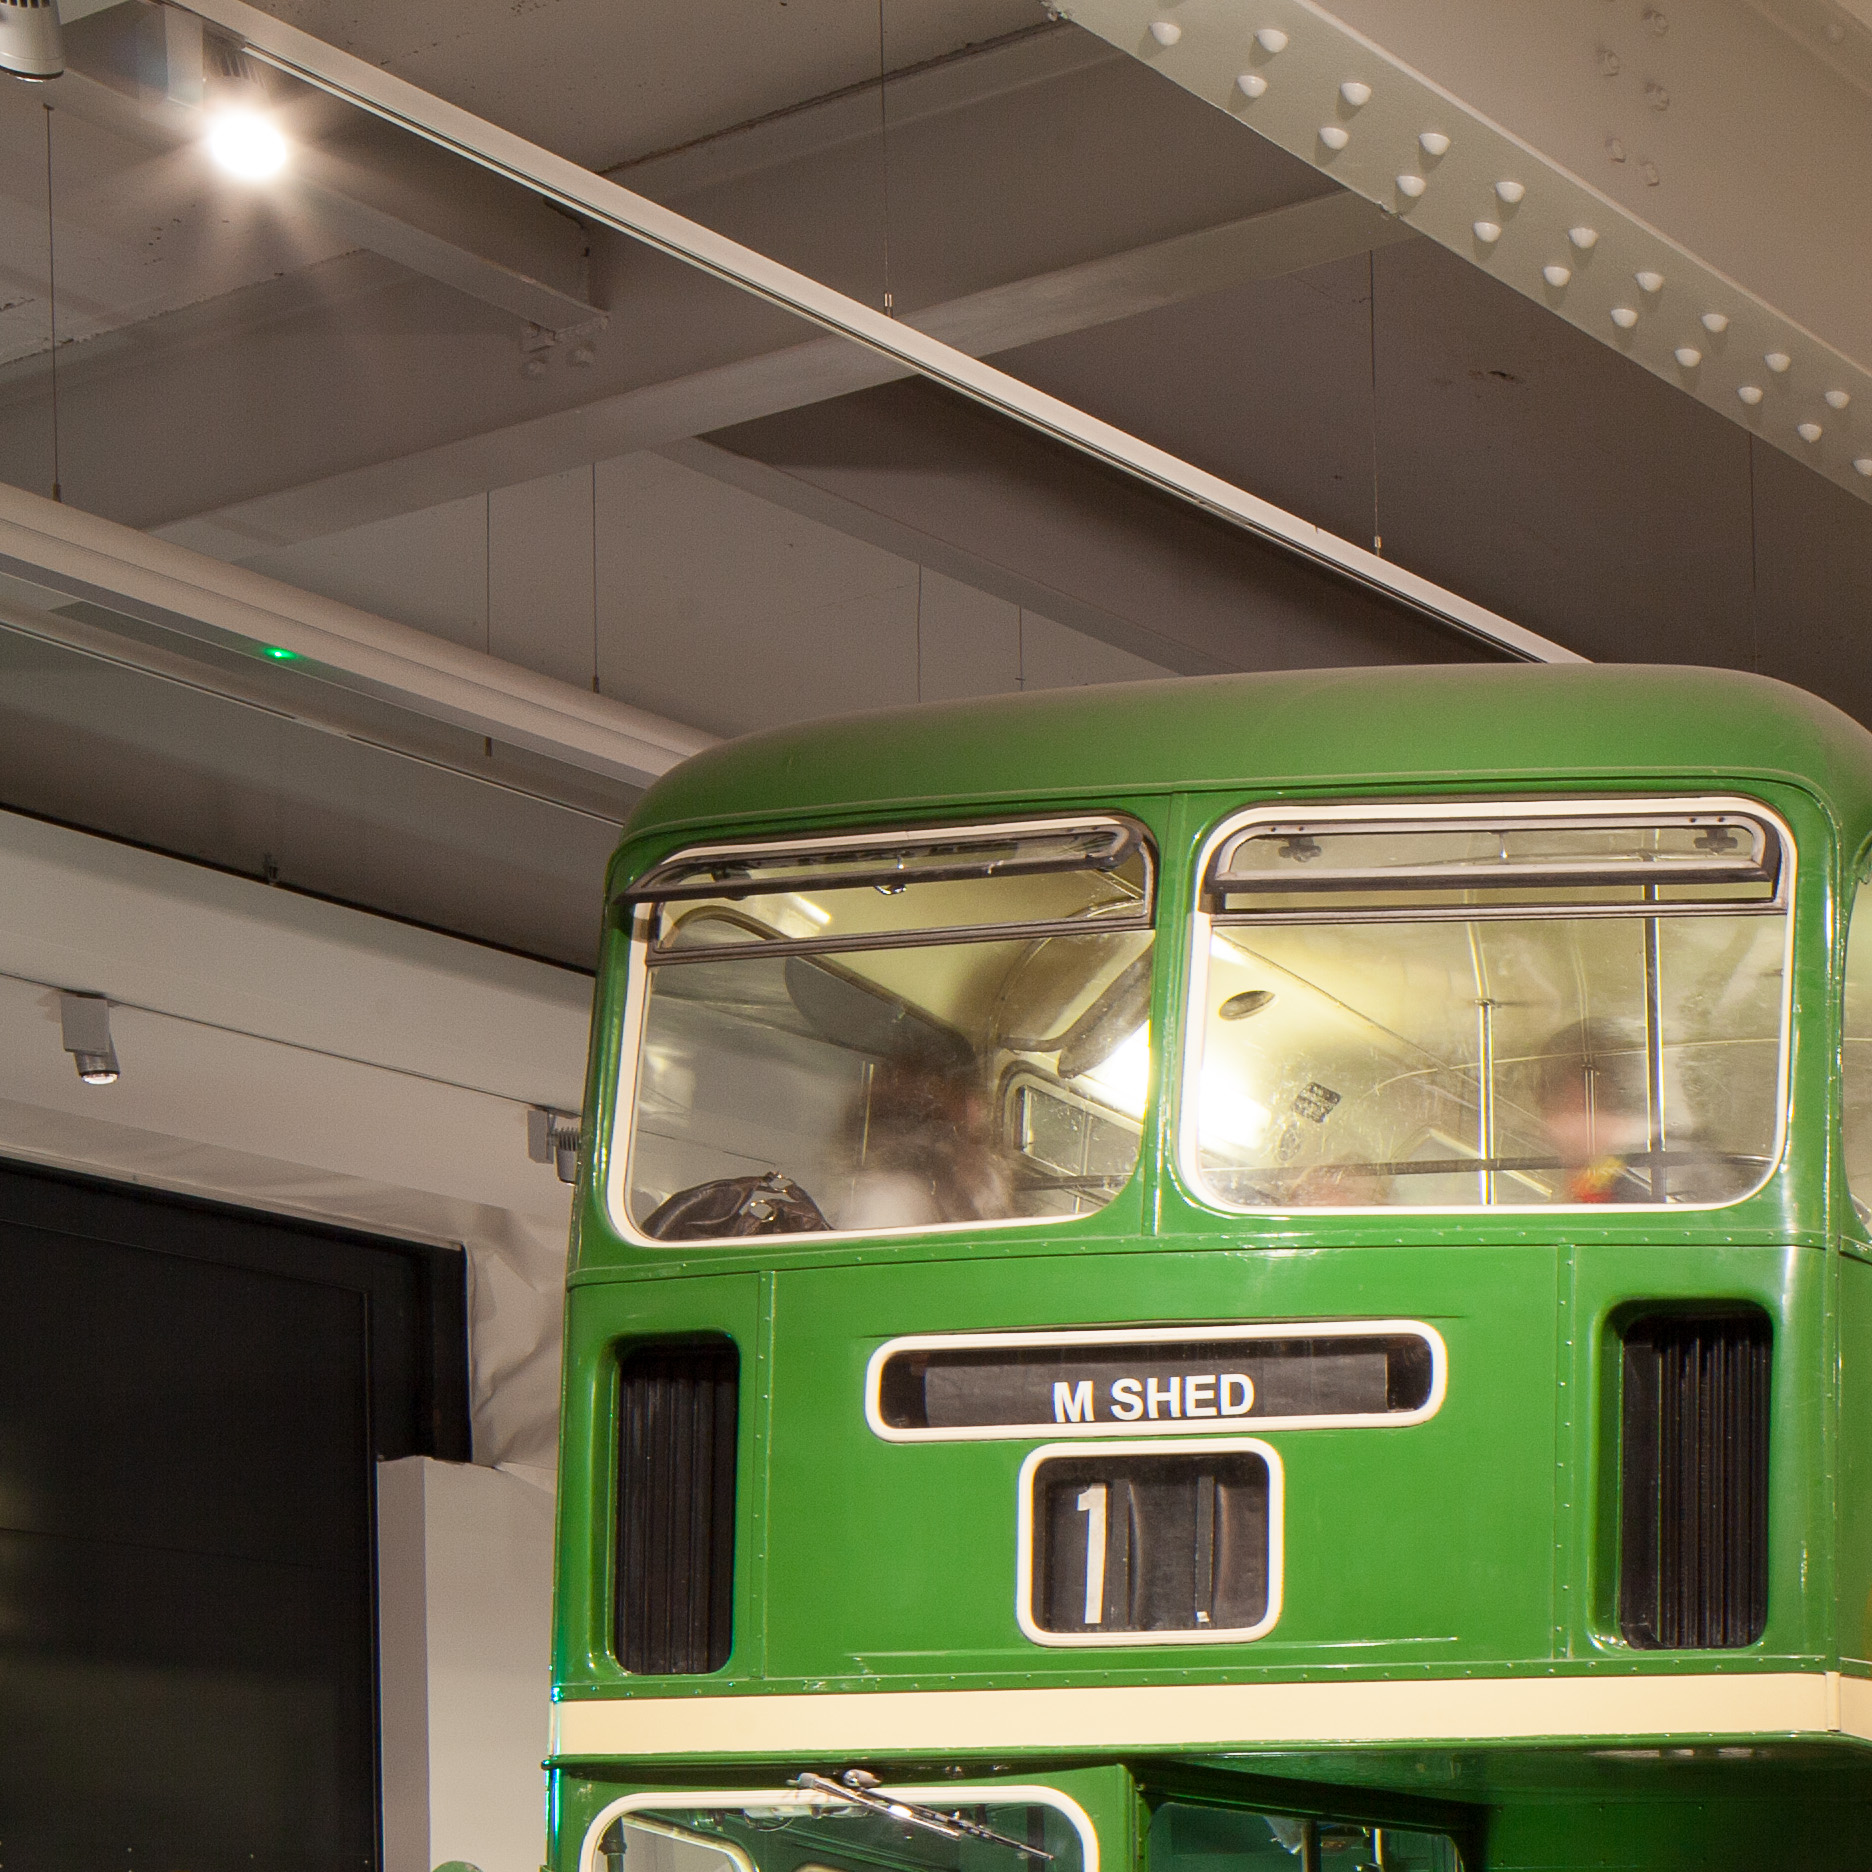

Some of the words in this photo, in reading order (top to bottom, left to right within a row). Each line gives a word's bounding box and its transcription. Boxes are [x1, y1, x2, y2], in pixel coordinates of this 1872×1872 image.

[1052, 1381, 1094, 1423] M
[1110, 1373, 1255, 1420] SHED
[1077, 1482, 1108, 1625] 1
